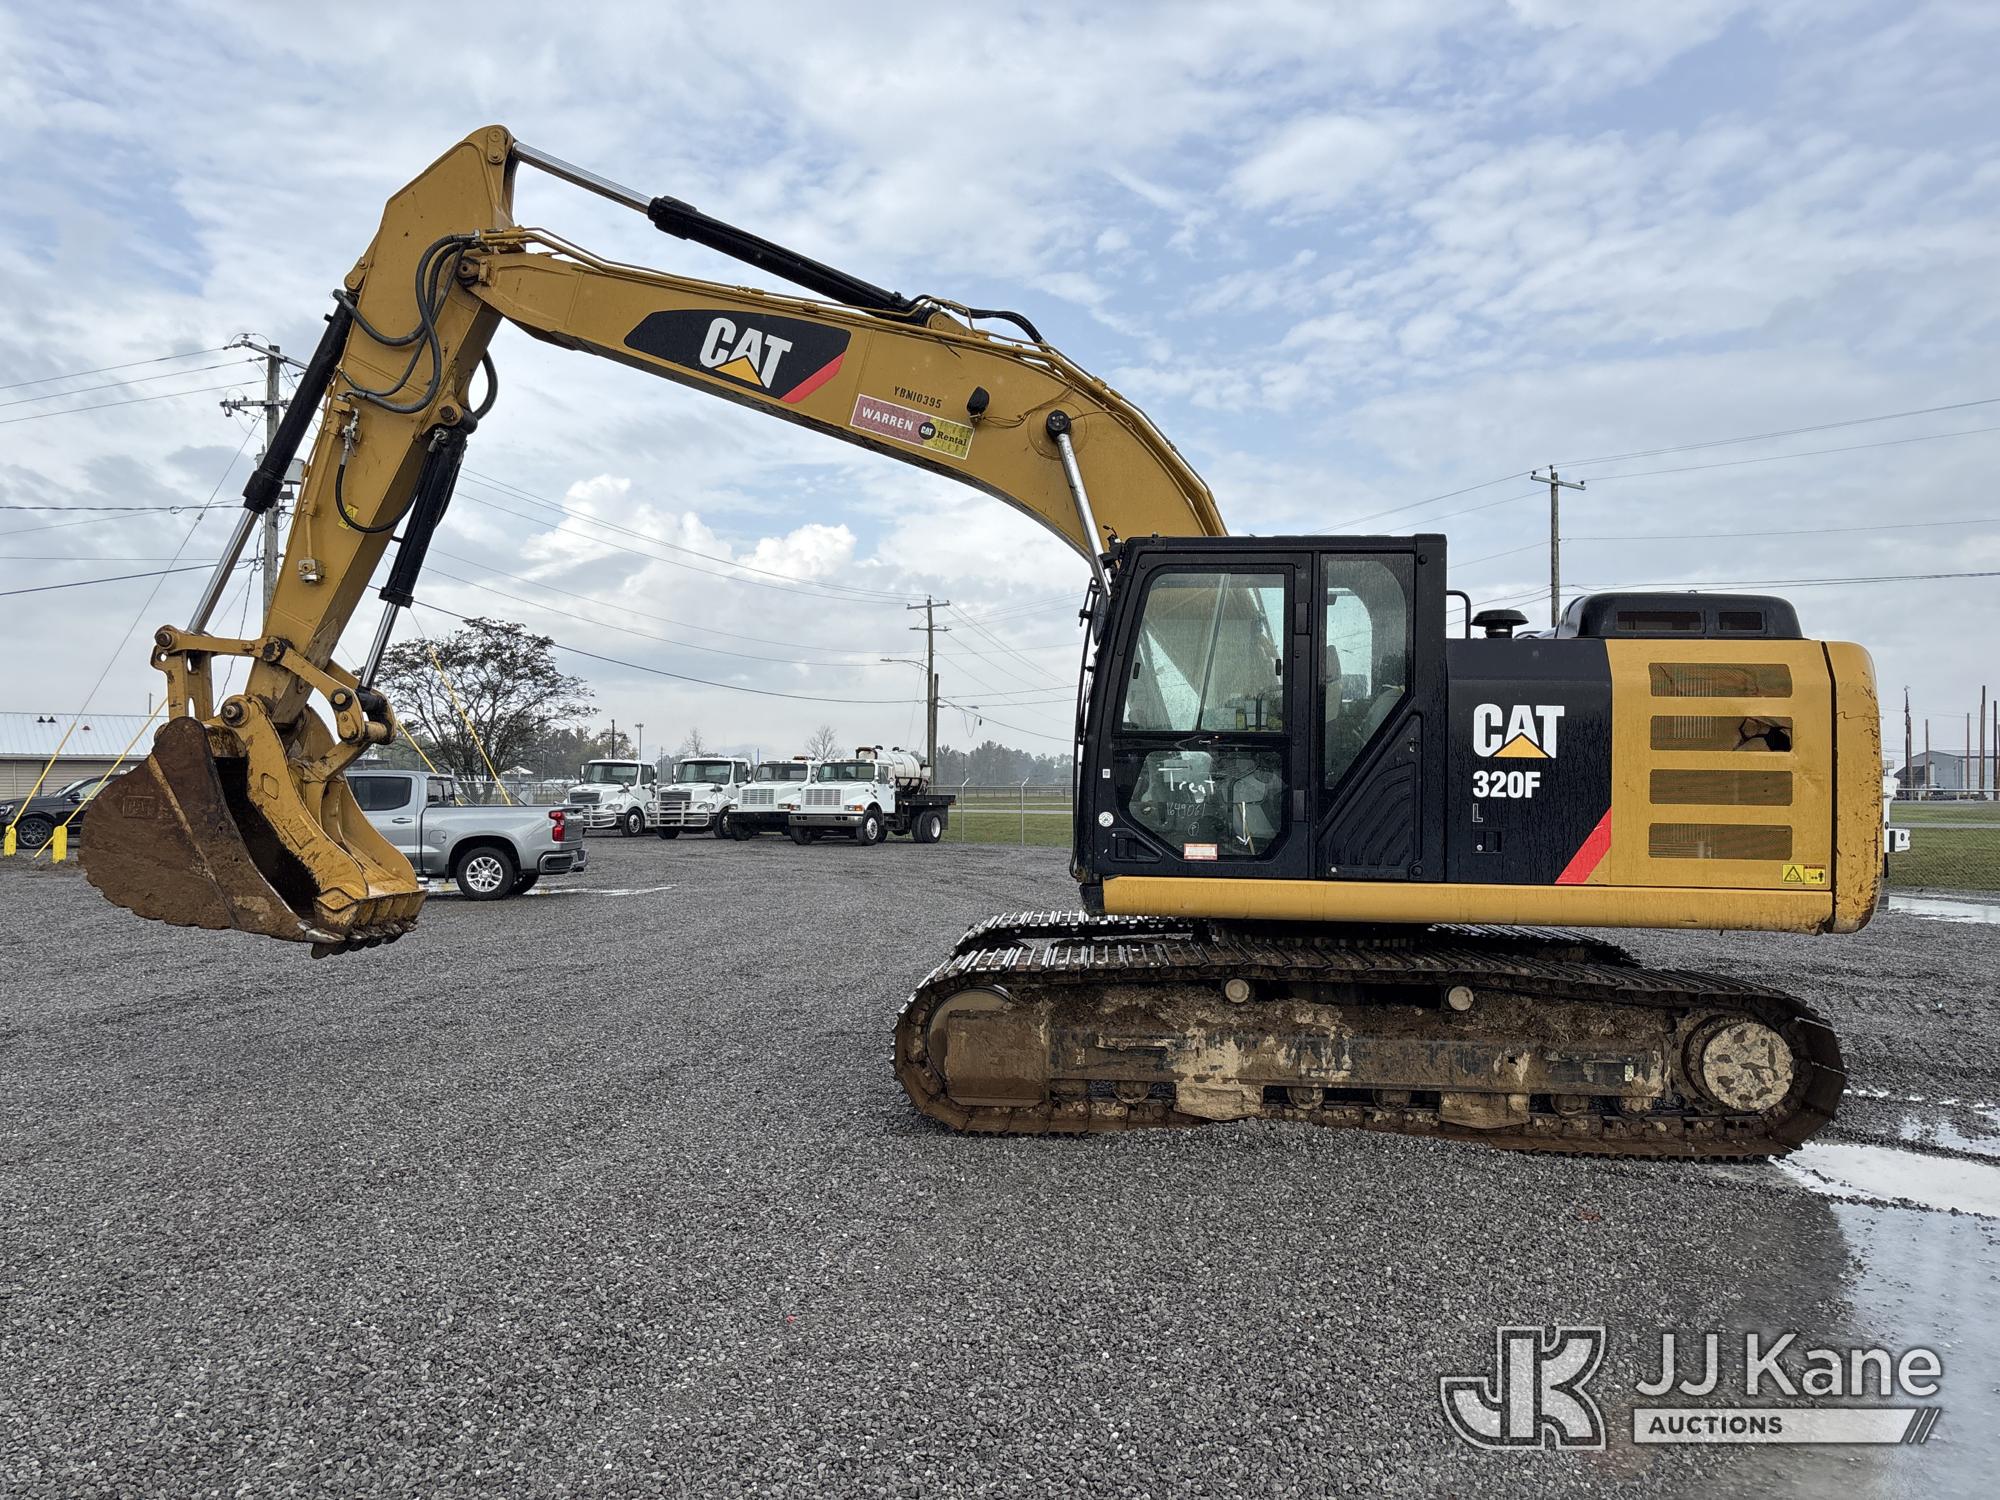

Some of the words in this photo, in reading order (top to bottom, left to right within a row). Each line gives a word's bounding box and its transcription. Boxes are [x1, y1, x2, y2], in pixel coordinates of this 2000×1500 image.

[700, 317, 793, 389] CAT
[862, 407, 914, 431] WARREN
[920, 425, 934, 436] CAT
[936, 430, 968, 446] Rental
[1473, 703, 1565, 758] CAT
[1472, 770, 1541, 798] 320F
[1472, 803, 1483, 822] L
